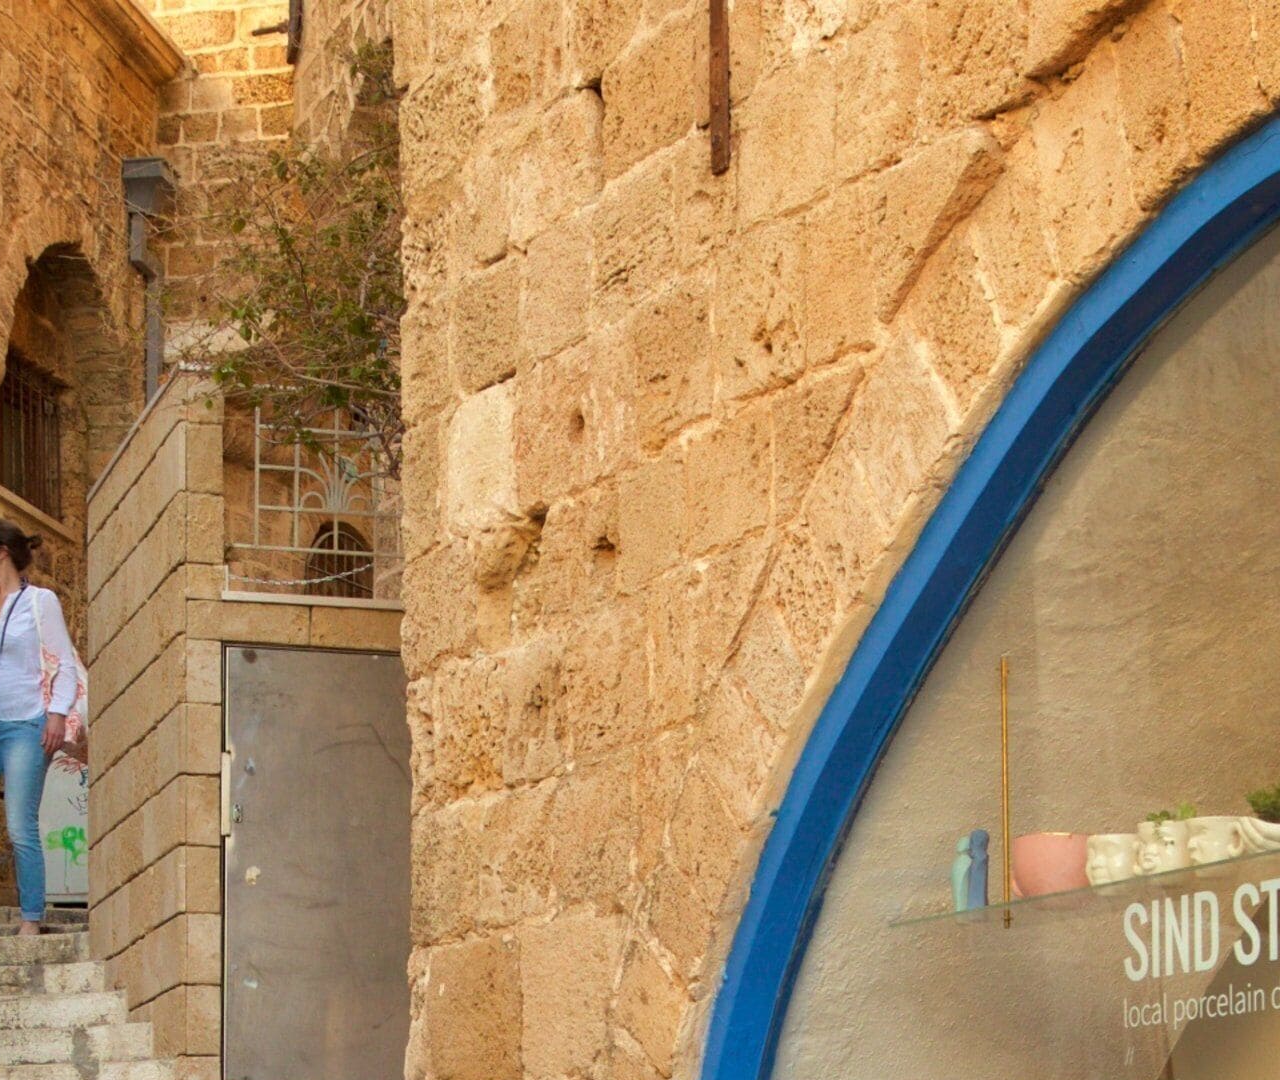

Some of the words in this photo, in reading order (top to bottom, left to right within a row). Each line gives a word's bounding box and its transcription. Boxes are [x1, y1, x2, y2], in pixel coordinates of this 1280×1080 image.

[1123, 890, 1219, 982] SIND
[1123, 992, 1169, 1029] local
[1173, 981, 1266, 1030] porcelain
